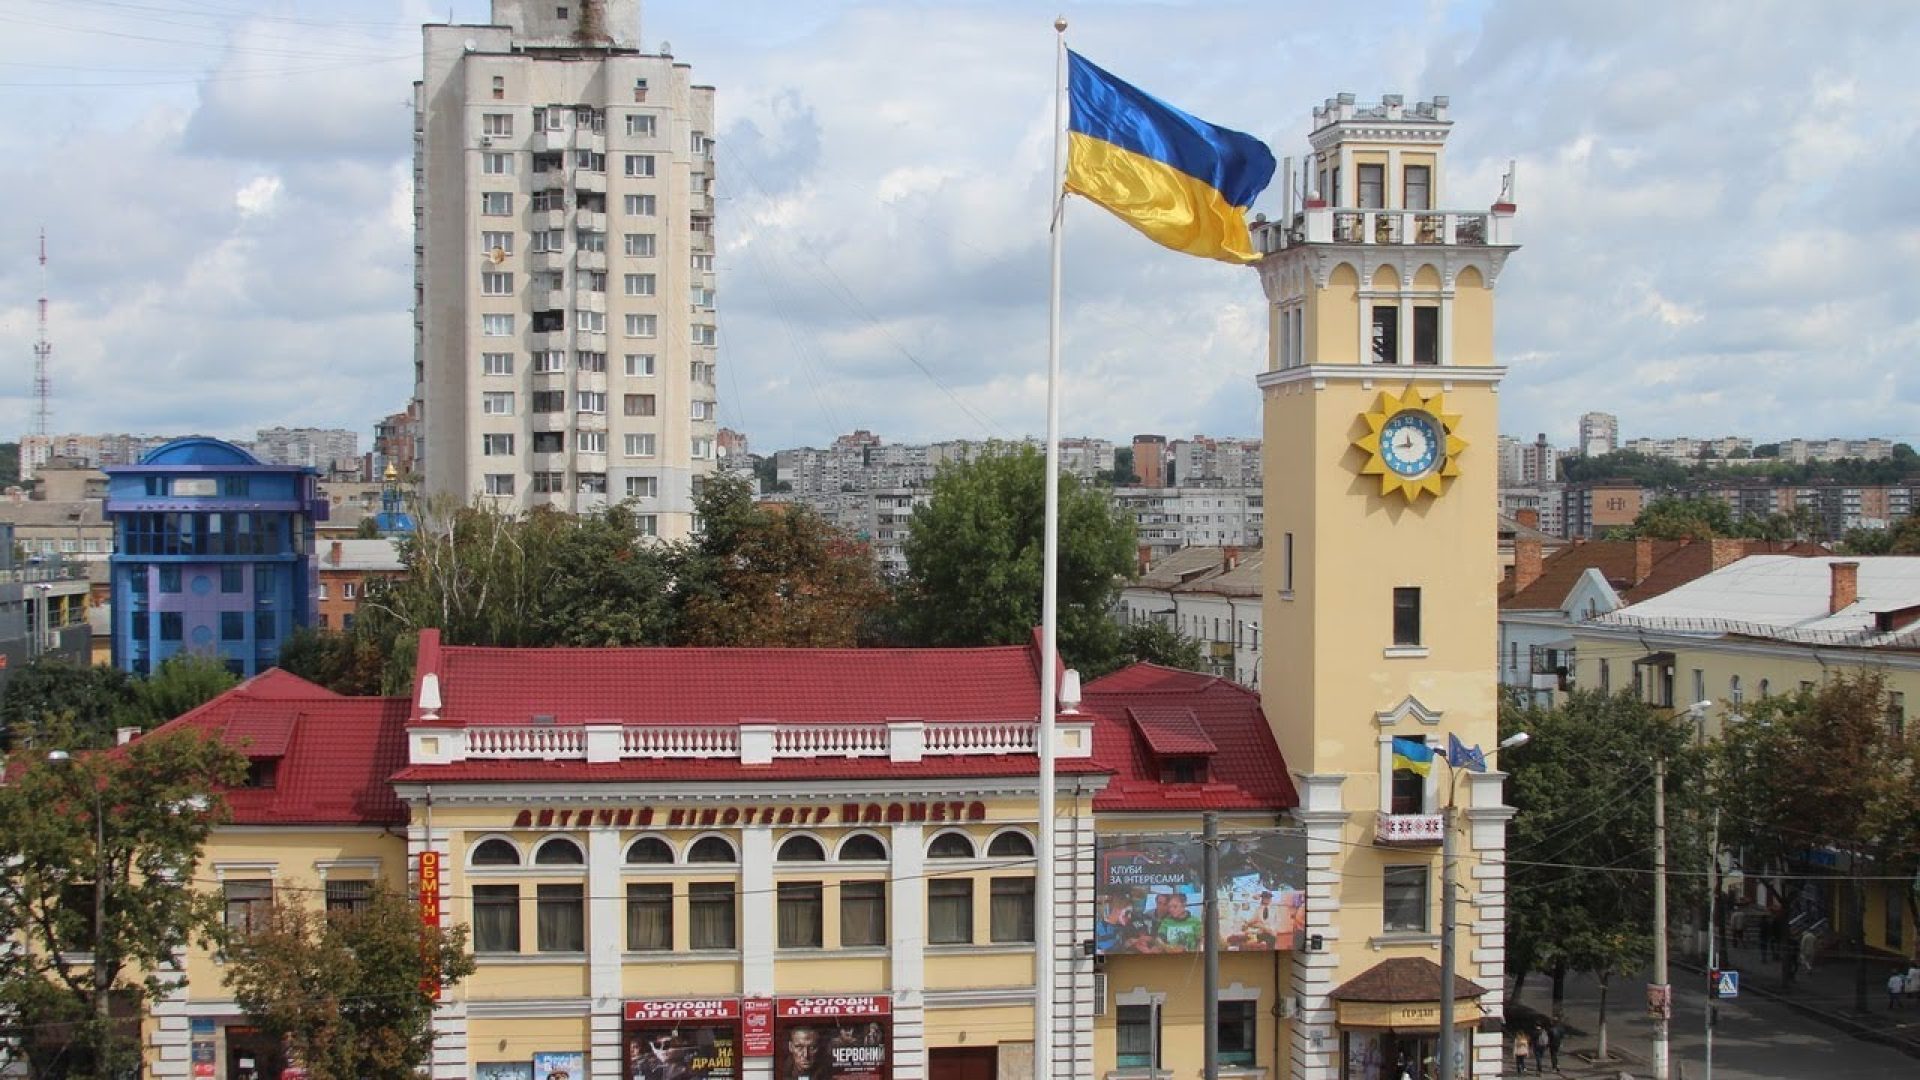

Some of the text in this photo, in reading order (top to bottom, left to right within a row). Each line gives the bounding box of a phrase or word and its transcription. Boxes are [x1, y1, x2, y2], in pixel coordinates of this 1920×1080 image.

[513, 801, 986, 827] ДИТЯЧИЙ КІНОТЕАТР ПЛАНЕТА
[1110, 865, 1142, 874] КЛУБИ
[1110, 874, 1184, 884] ЗА ІНТЕРЕСАМИ
[643, 1001, 722, 1010] СЬОГОДНІ
[795, 997, 874, 1006] СЬОГОДНІ
